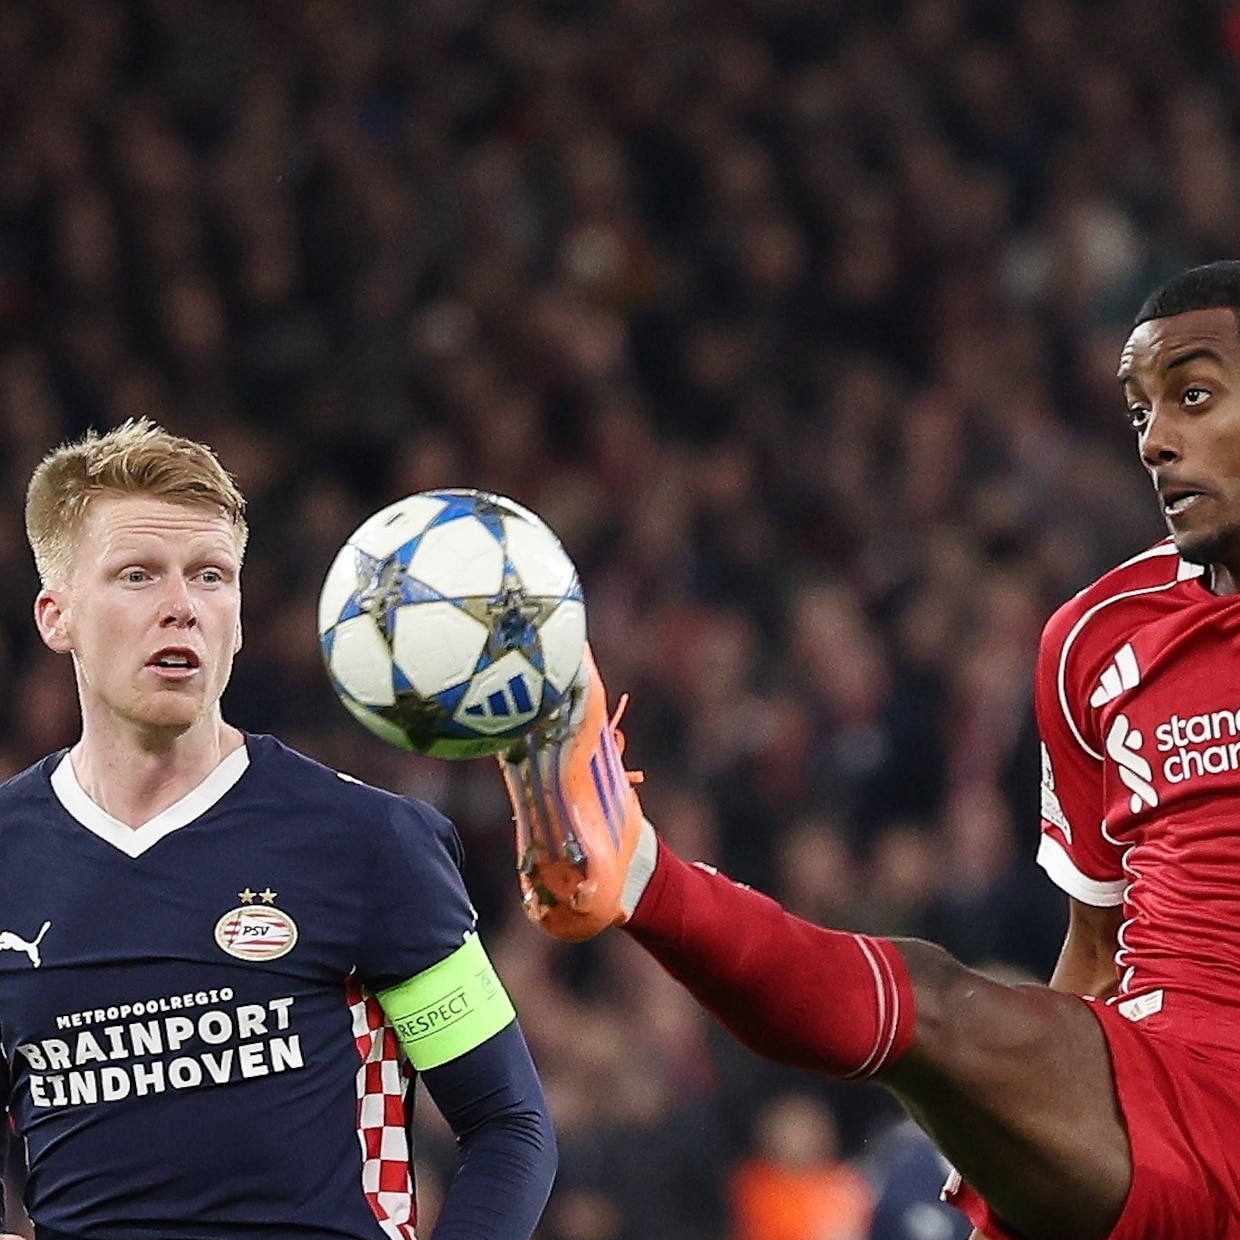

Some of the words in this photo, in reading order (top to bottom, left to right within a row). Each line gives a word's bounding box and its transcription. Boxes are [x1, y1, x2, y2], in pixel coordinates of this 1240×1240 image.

[242, 926, 271, 936] PSV
[56, 987, 234, 1030] METROPOOLREGIO
[397, 992, 468, 1039] RESPECT
[17, 998, 294, 1071] BRAINPORT
[29, 1035, 304, 1107] EINDHOVEN
